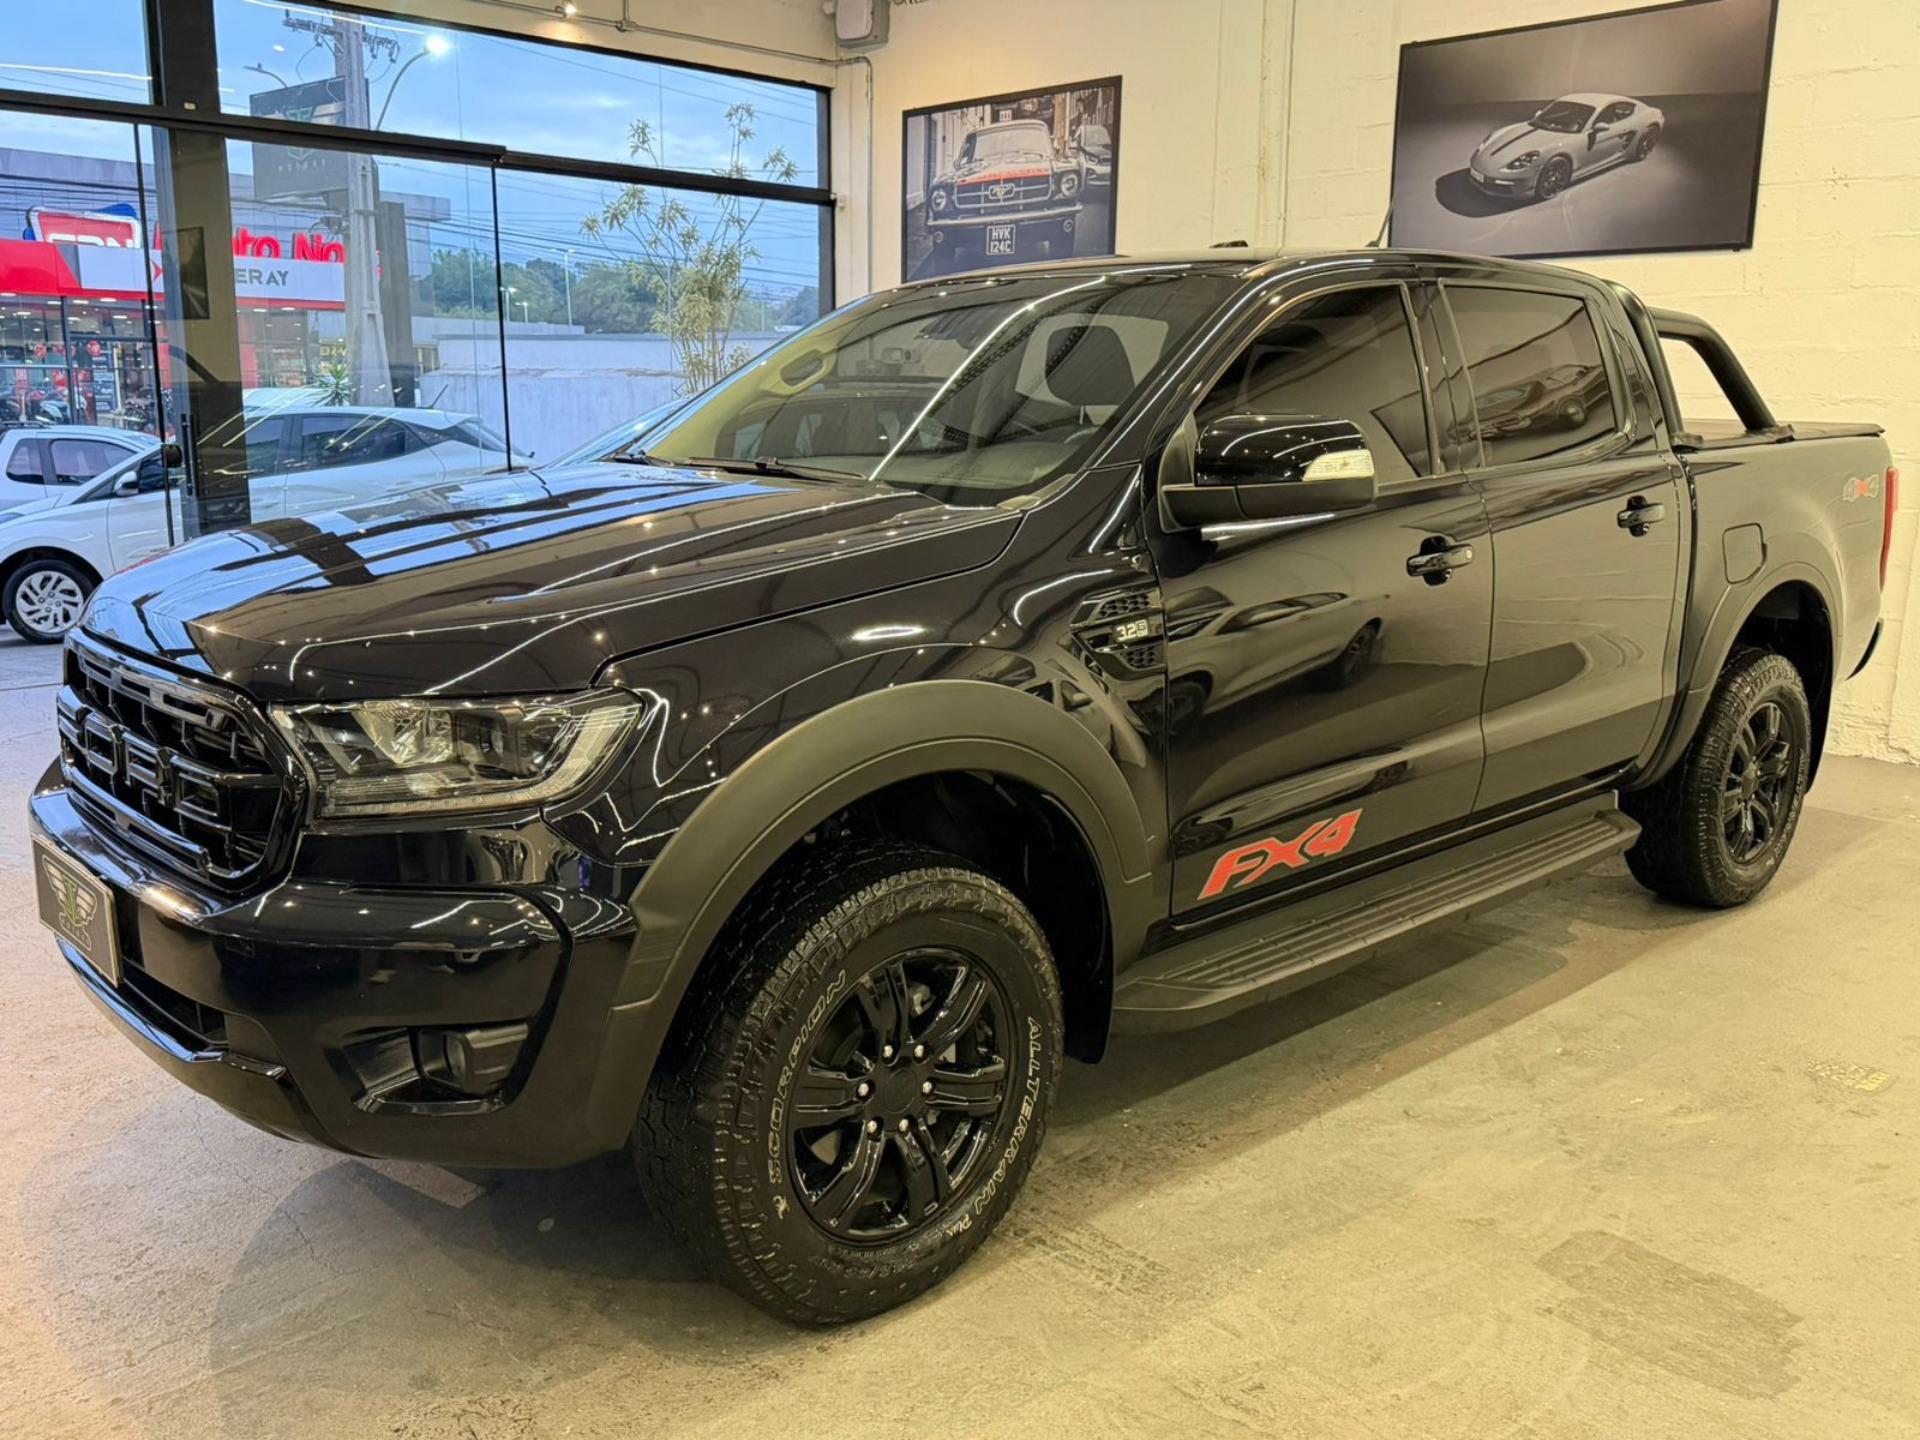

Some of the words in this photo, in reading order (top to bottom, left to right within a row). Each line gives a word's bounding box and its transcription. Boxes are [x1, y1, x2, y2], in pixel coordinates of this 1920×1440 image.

[991, 228, 1012, 240] HVK
[235, 268, 289, 286] ERAY
[1197, 808, 1363, 900] FX4
[768, 969, 846, 1184] SCORPION
